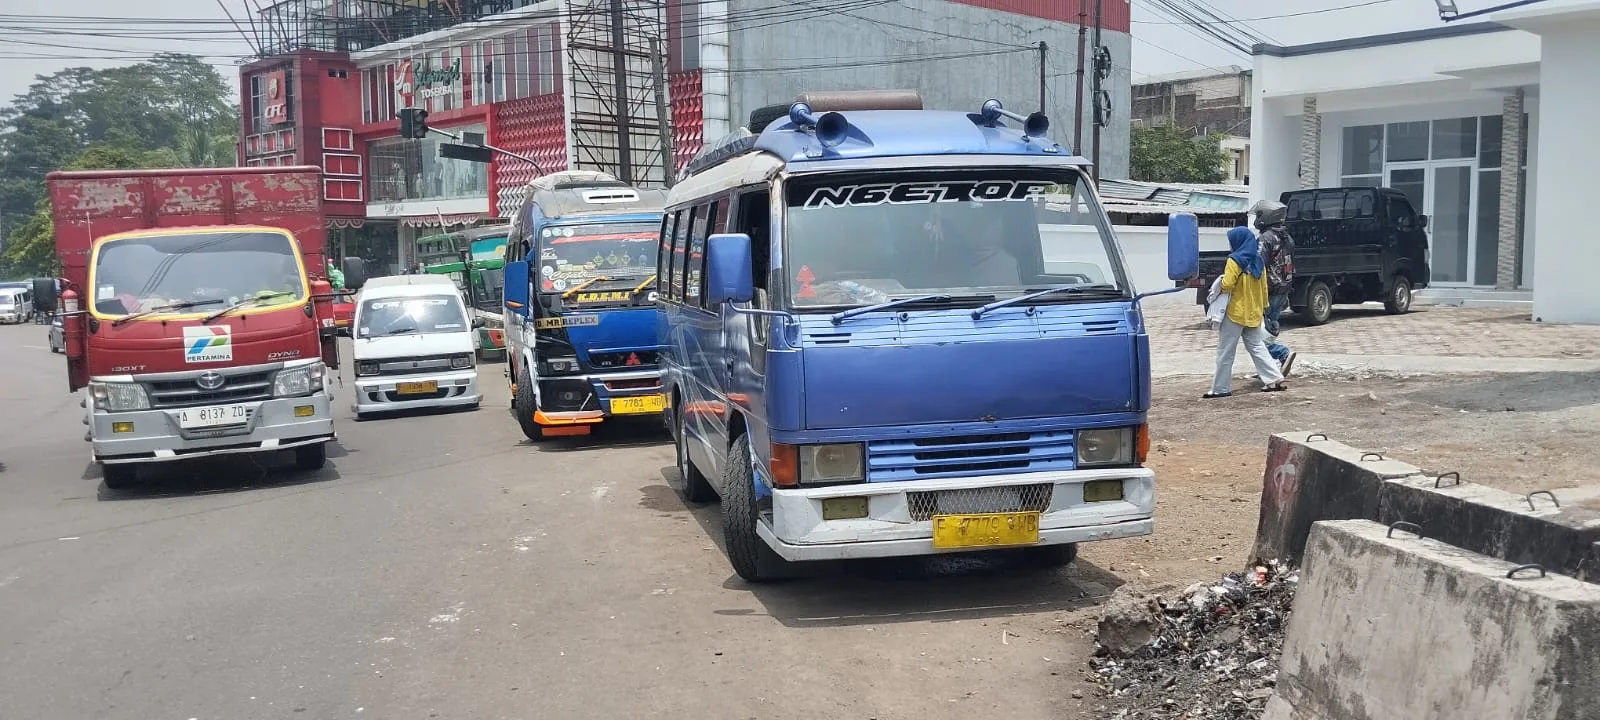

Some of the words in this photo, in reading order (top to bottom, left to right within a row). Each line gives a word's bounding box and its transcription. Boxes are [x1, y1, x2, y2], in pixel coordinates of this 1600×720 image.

[421, 85, 454, 99] TOSERBA
[264, 103, 285, 119] CFC
[623, 398, 645, 408] 7781
[199, 408, 225, 421] 8137
[937, 518, 946, 536] F
[962, 515, 999, 535] 7779
